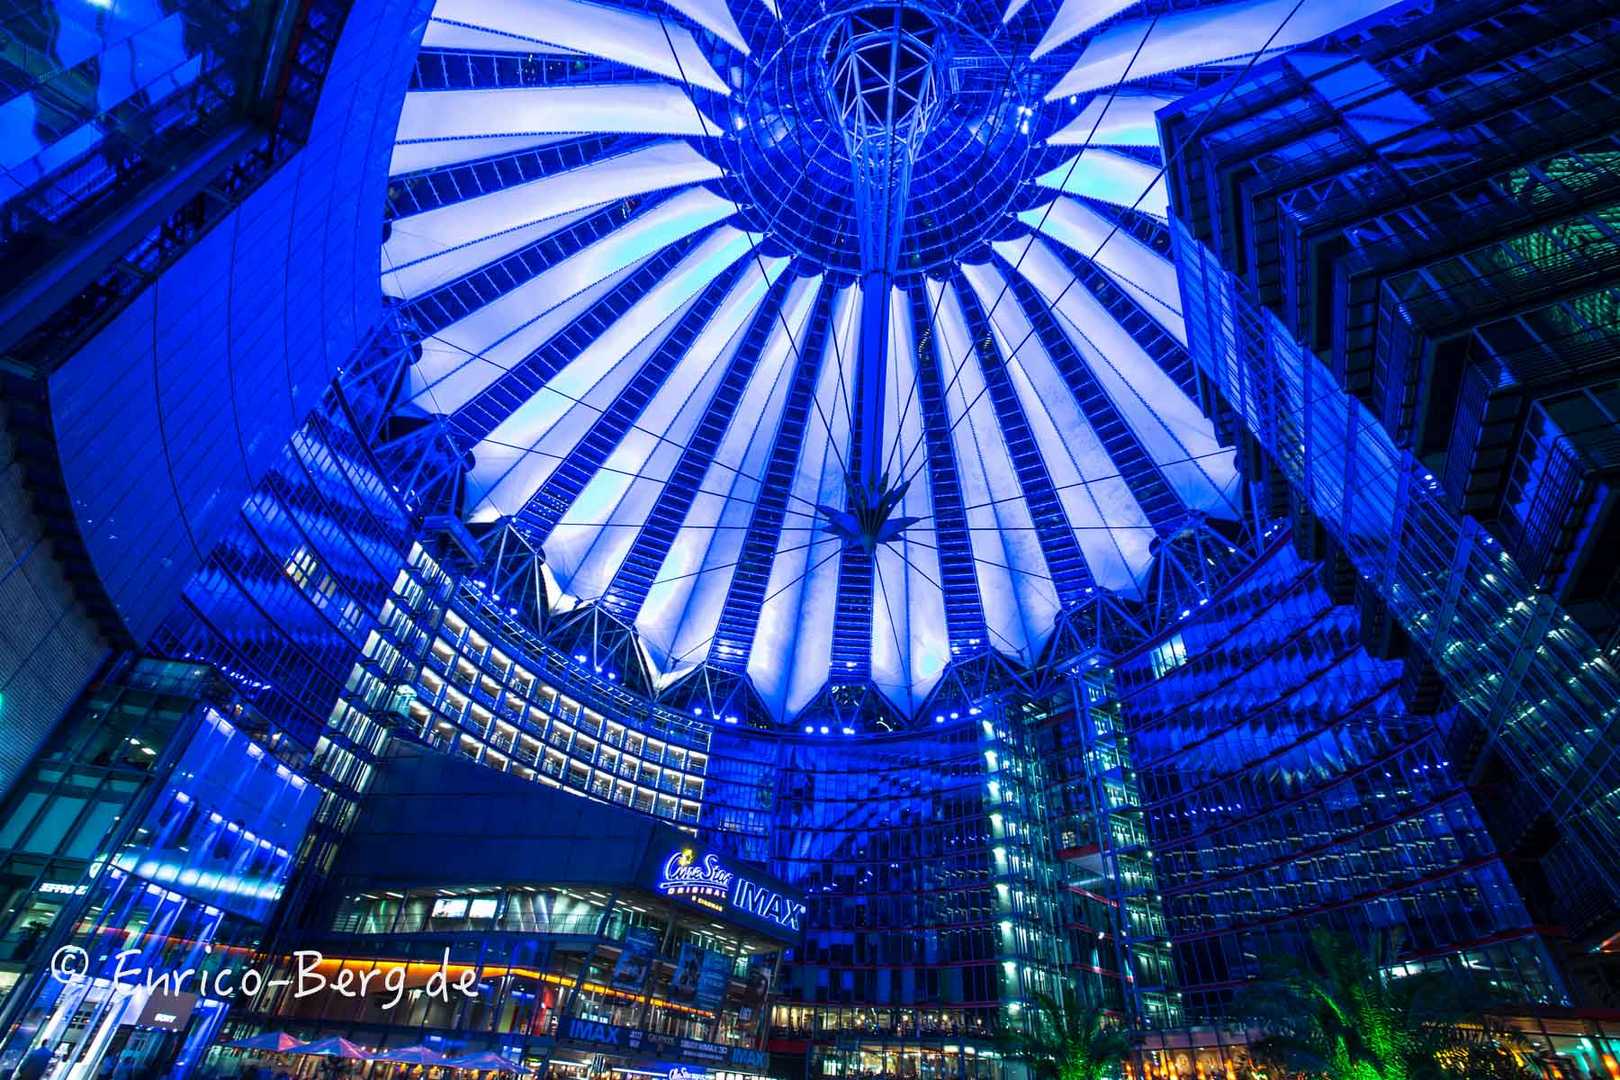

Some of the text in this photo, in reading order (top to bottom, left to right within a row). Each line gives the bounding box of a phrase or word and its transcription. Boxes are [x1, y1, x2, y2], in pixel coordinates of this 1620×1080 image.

[664, 851, 734, 884] CineStar
[667, 886, 727, 899] ORIGINAL
[733, 877, 800, 931] IMAX
[569, 1019, 620, 1045] IMAX
